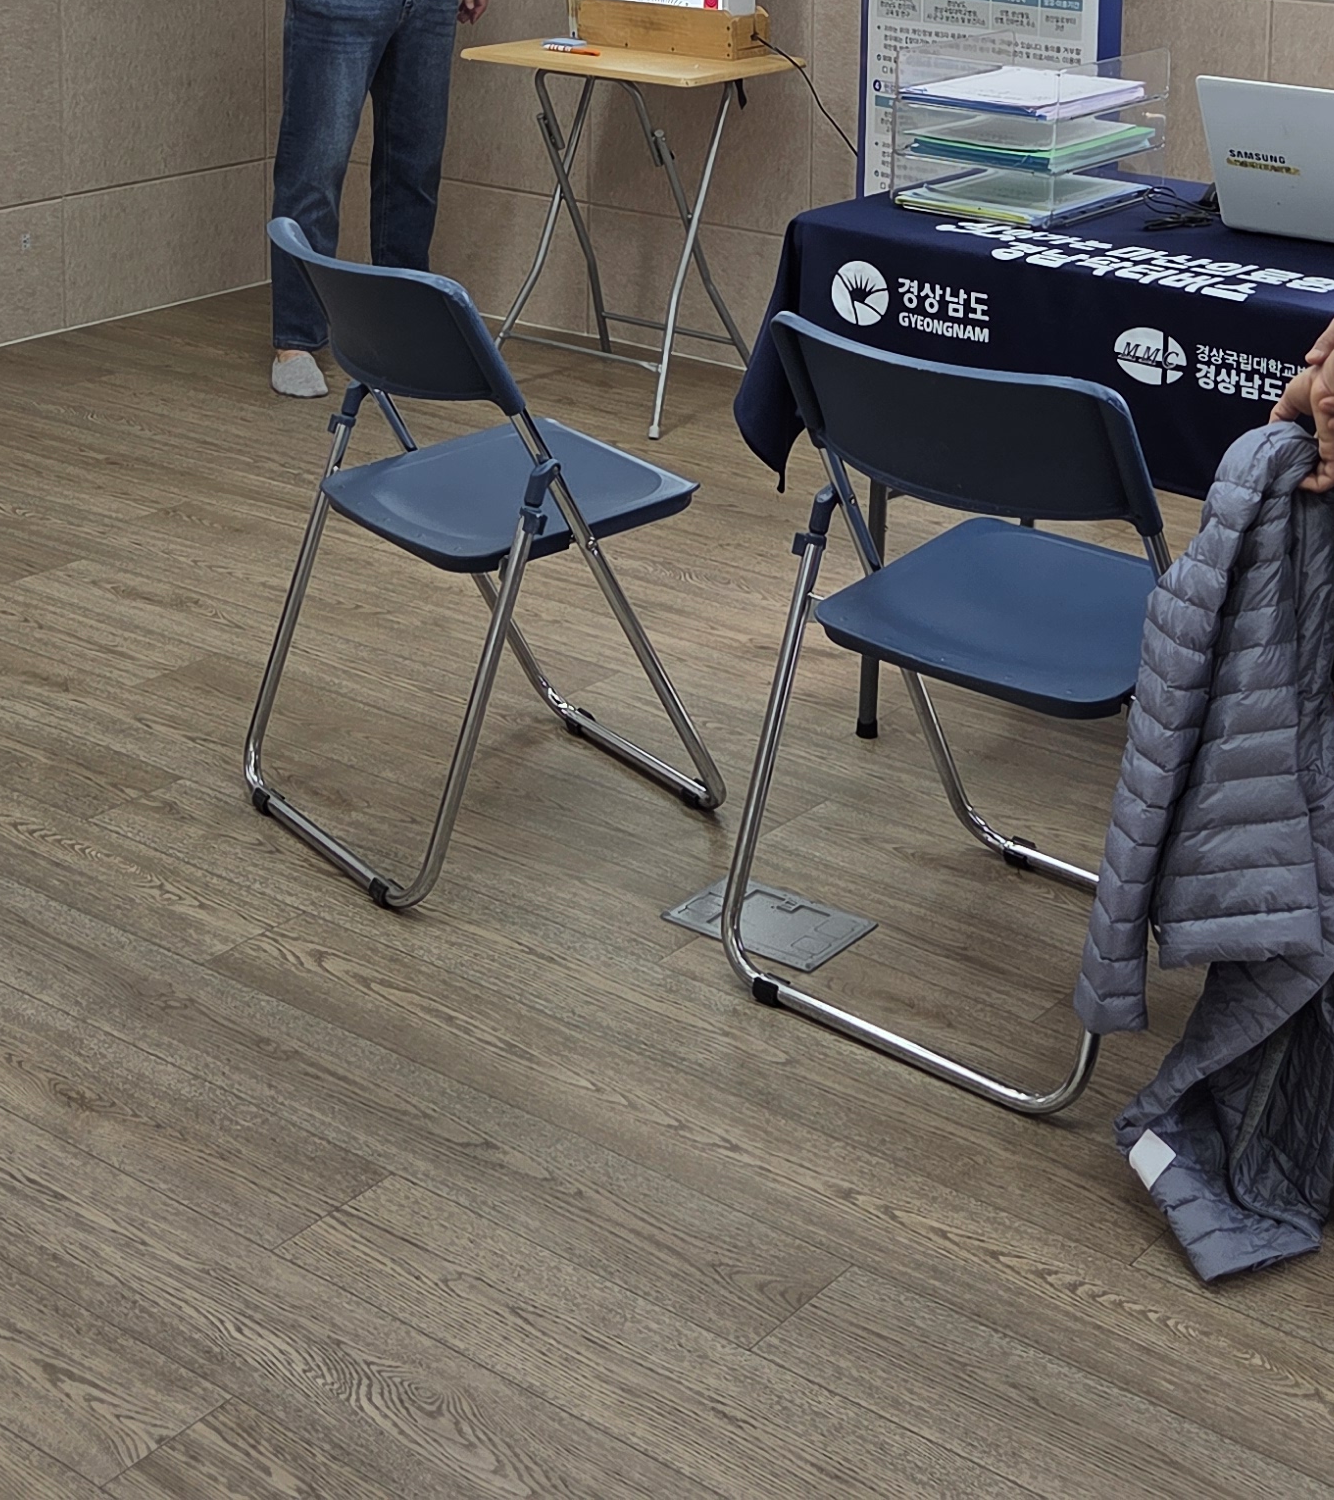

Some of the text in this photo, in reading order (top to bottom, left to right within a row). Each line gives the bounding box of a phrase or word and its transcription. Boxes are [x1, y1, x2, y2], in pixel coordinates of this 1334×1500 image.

[1229, 149, 1285, 164] SAMSUNG
[935, 221, 1112, 251] 찾아가는
[990, 241, 1258, 301] 경남닥터버스
[897, 277, 990, 322] 경상남도
[898, 311, 989, 343] GYEONGNAM
